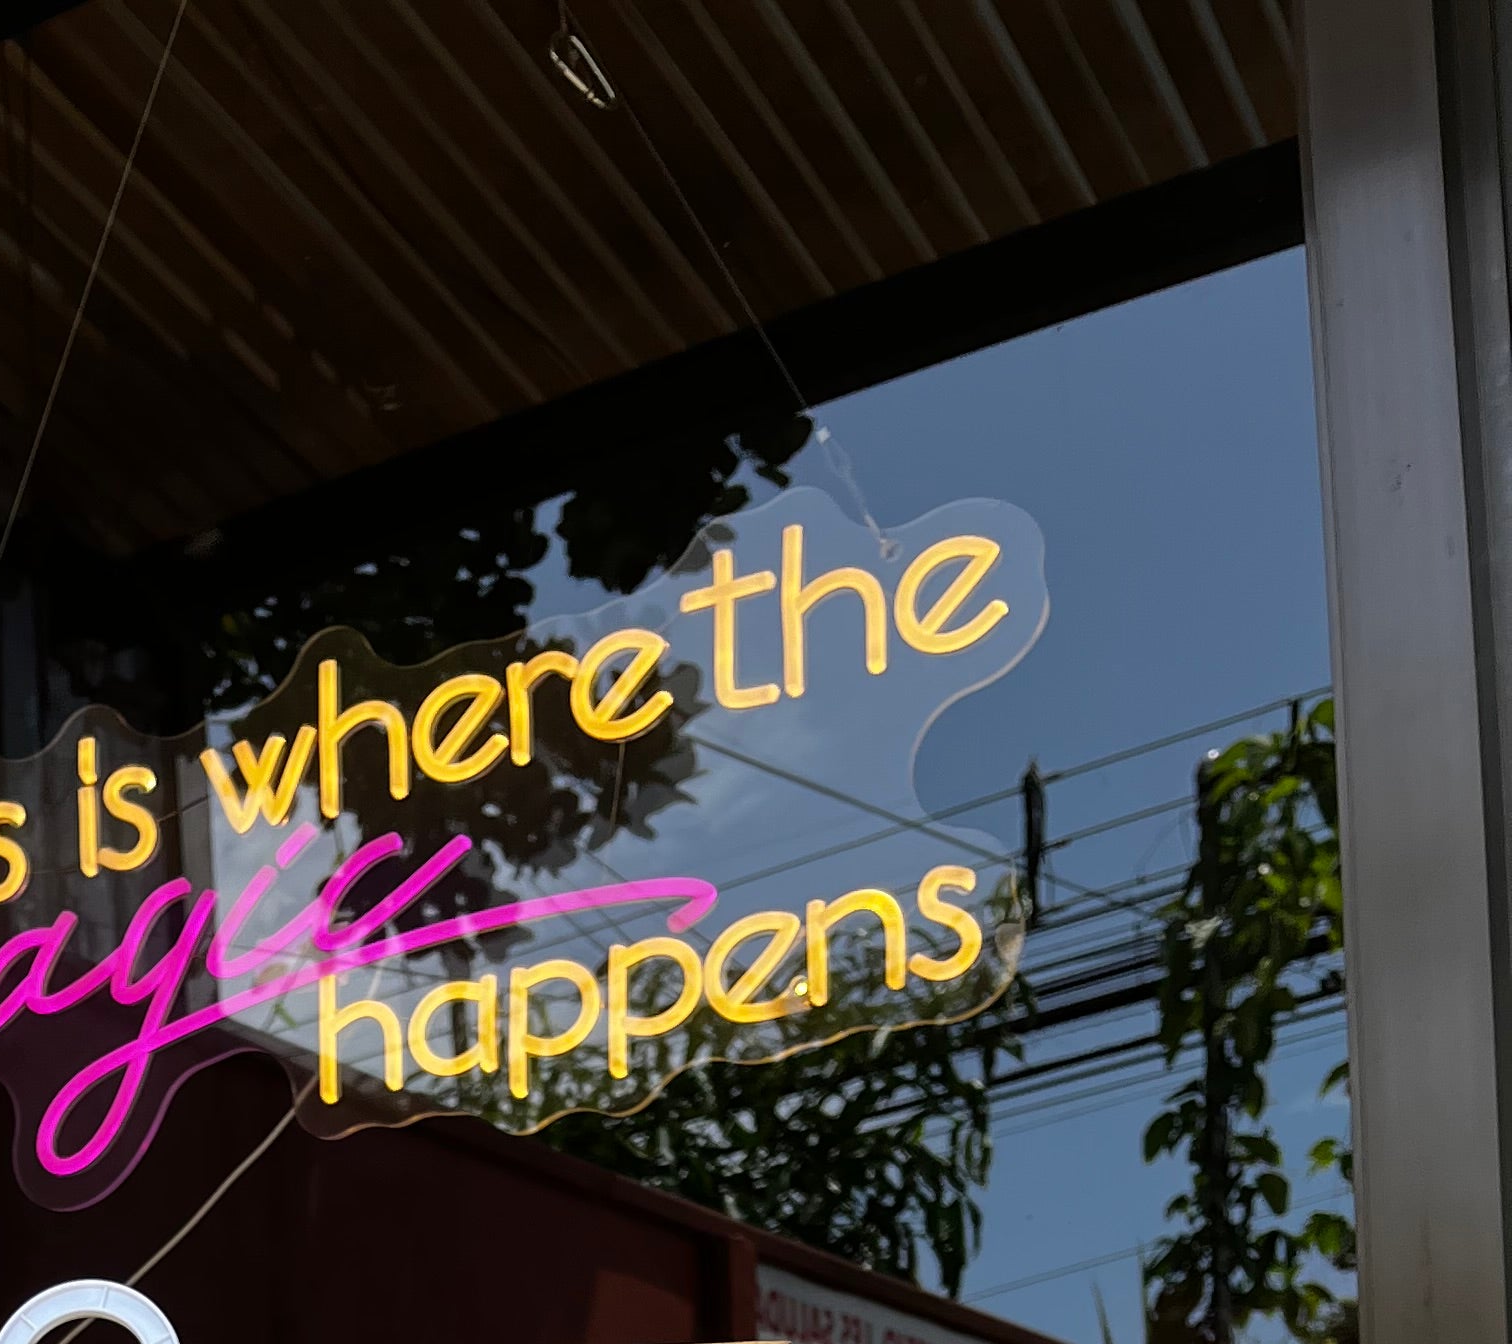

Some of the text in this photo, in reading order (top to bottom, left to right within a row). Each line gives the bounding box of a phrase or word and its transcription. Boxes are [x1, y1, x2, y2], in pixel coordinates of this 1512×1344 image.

[77, 736, 159, 879] is
[199, 629, 675, 836] where
[679, 525, 1008, 710] the
[317, 866, 984, 1106] happens
